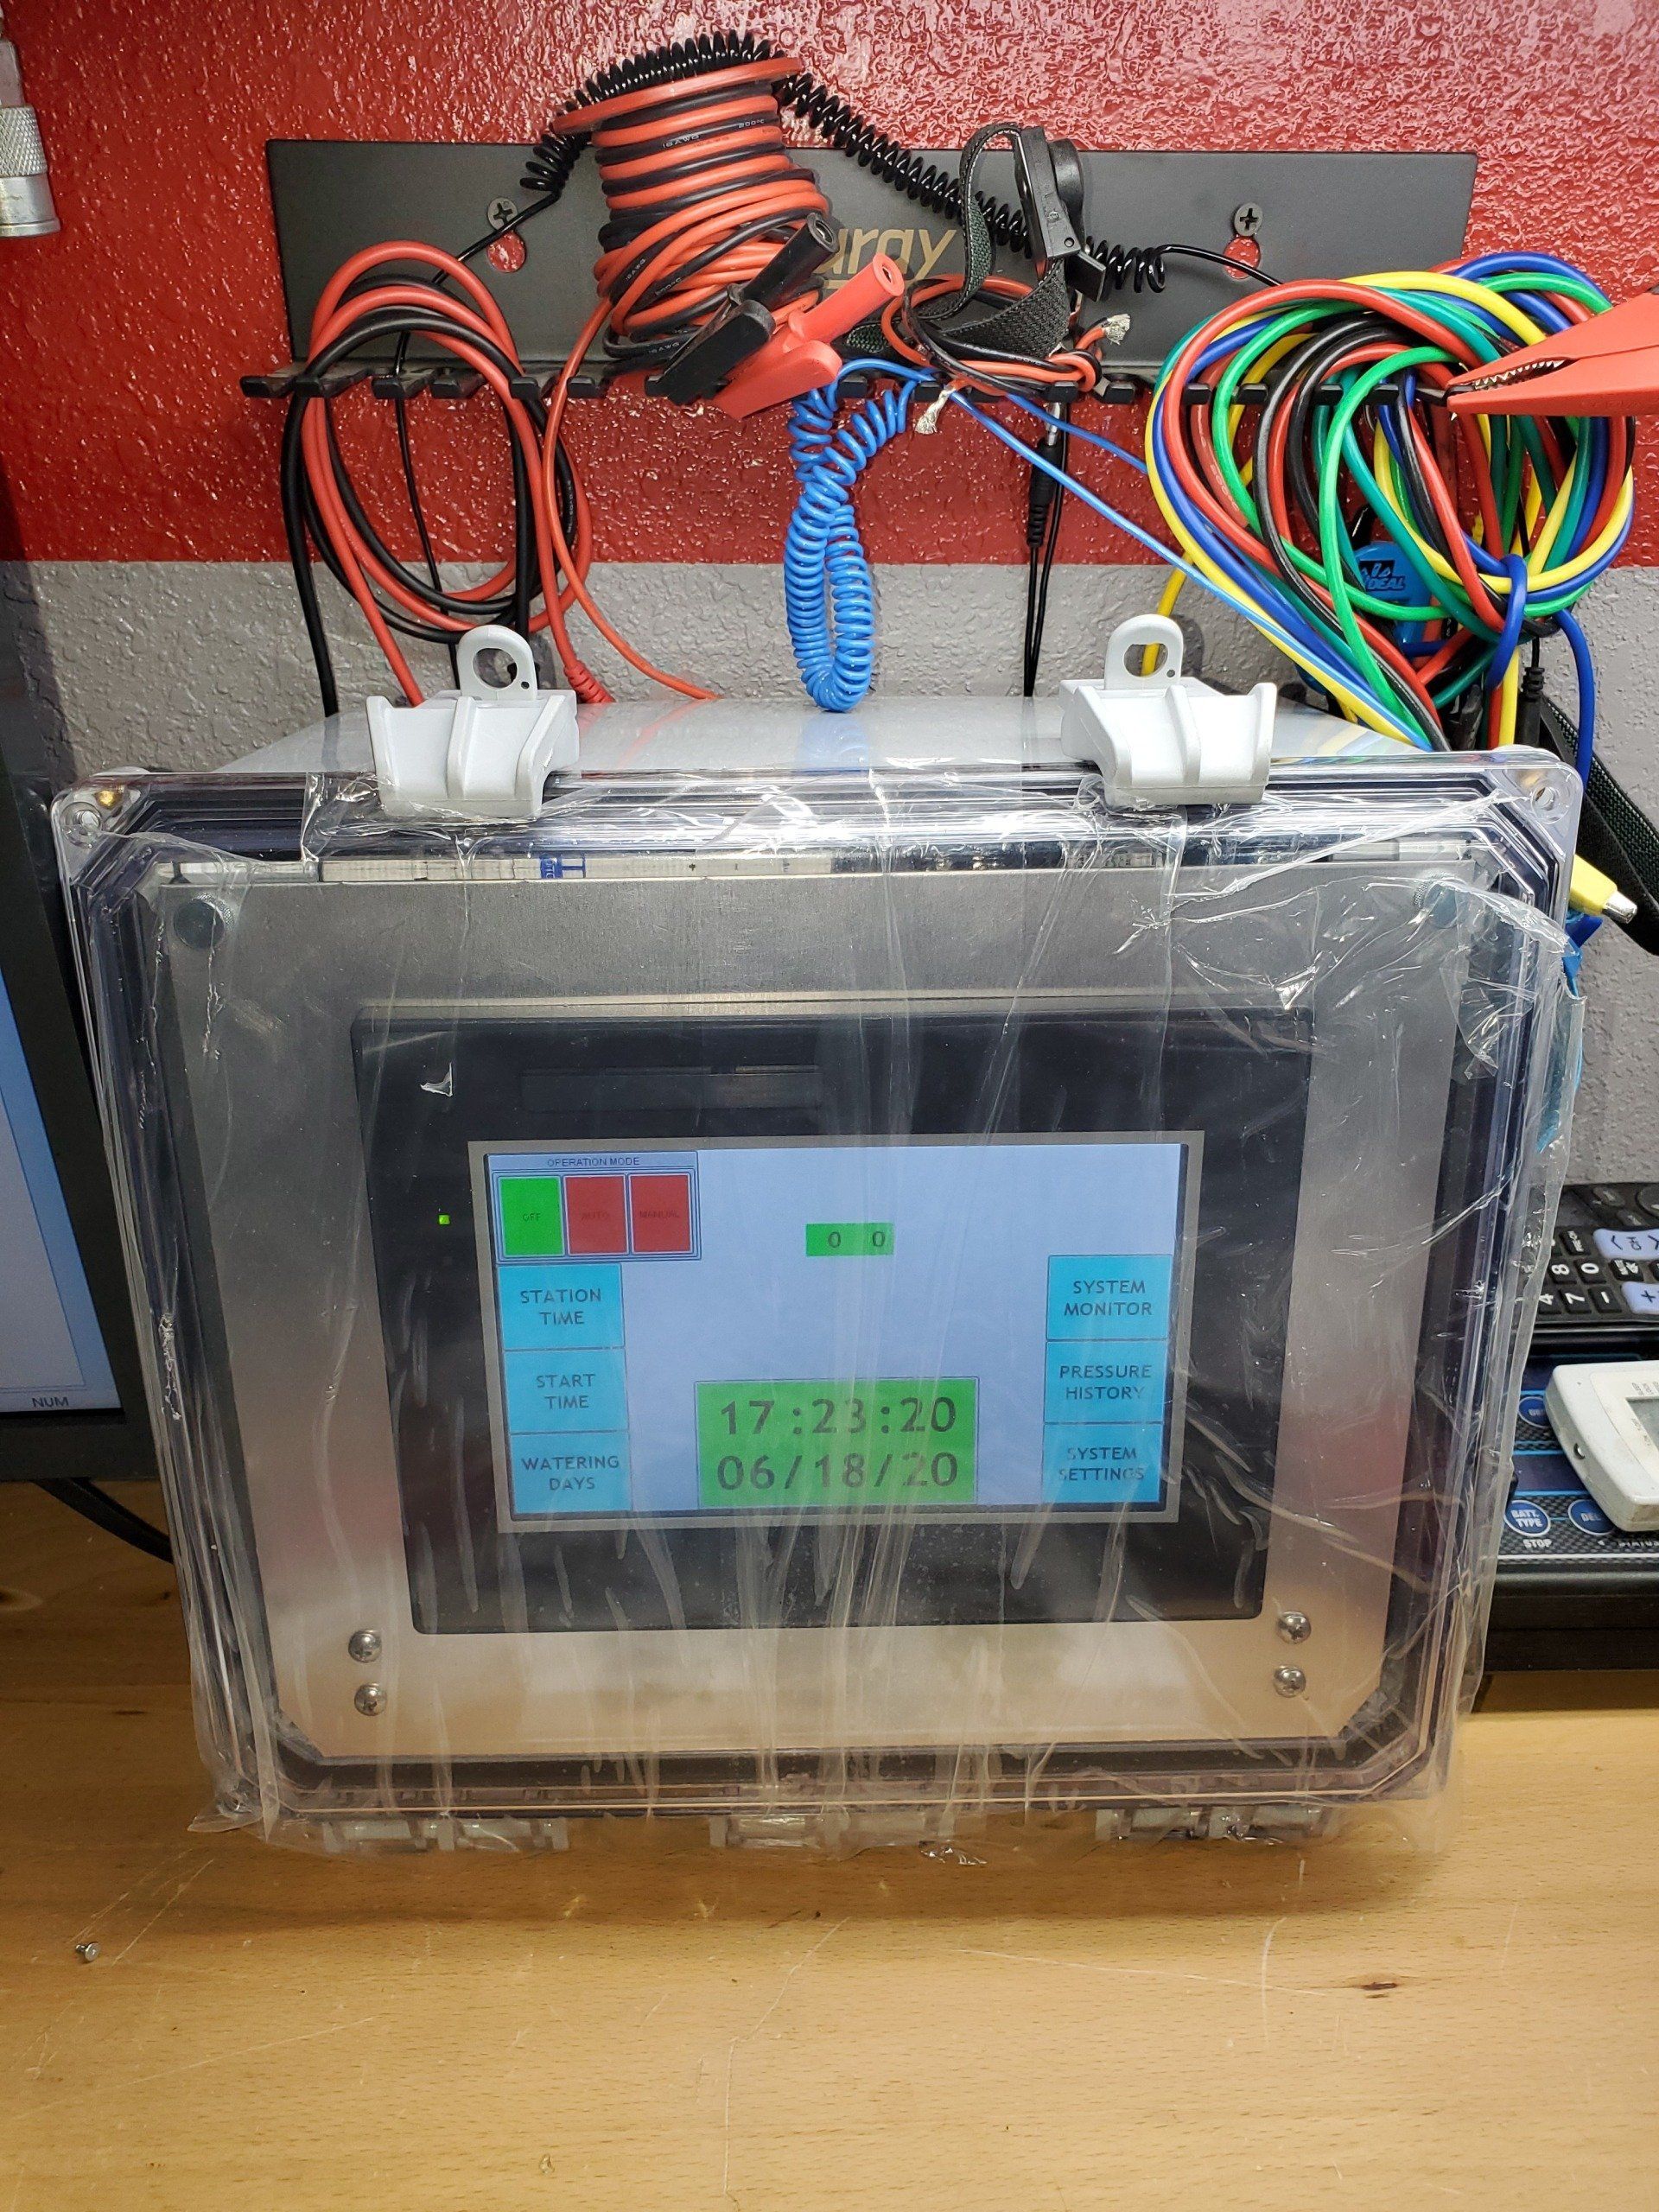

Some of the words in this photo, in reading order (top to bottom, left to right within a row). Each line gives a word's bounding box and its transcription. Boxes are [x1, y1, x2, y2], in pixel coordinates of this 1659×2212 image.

[547, 1157, 607, 1167] OPERATION
[610, 1156, 640, 1166] MODE
[1072, 1280, 1146, 1294] SYSTEM
[520, 1288, 602, 1305] STATION
[1063, 1301, 1153, 1317] MONITOR
[539, 1311, 585, 1326] TIME
[1059, 1363, 1152, 1379] PRESSURE
[536, 1373, 595, 1389] START
[1065, 1385, 1145, 1401] HISTORY
[32, 1396, 69, 1408] NUM
[544, 1395, 589, 1410] TIME
[1066, 1446, 1137, 1461] SYSTEM
[521, 1455, 620, 1471] WATERING
[716, 1452, 958, 1491] 06/18/20
[1058, 1466, 1145, 1482] SETTINGS
[549, 1476, 595, 1492] DAYS
[1514, 1518, 1543, 1528] TYPE
[1522, 1538, 1553, 1548] STOP
